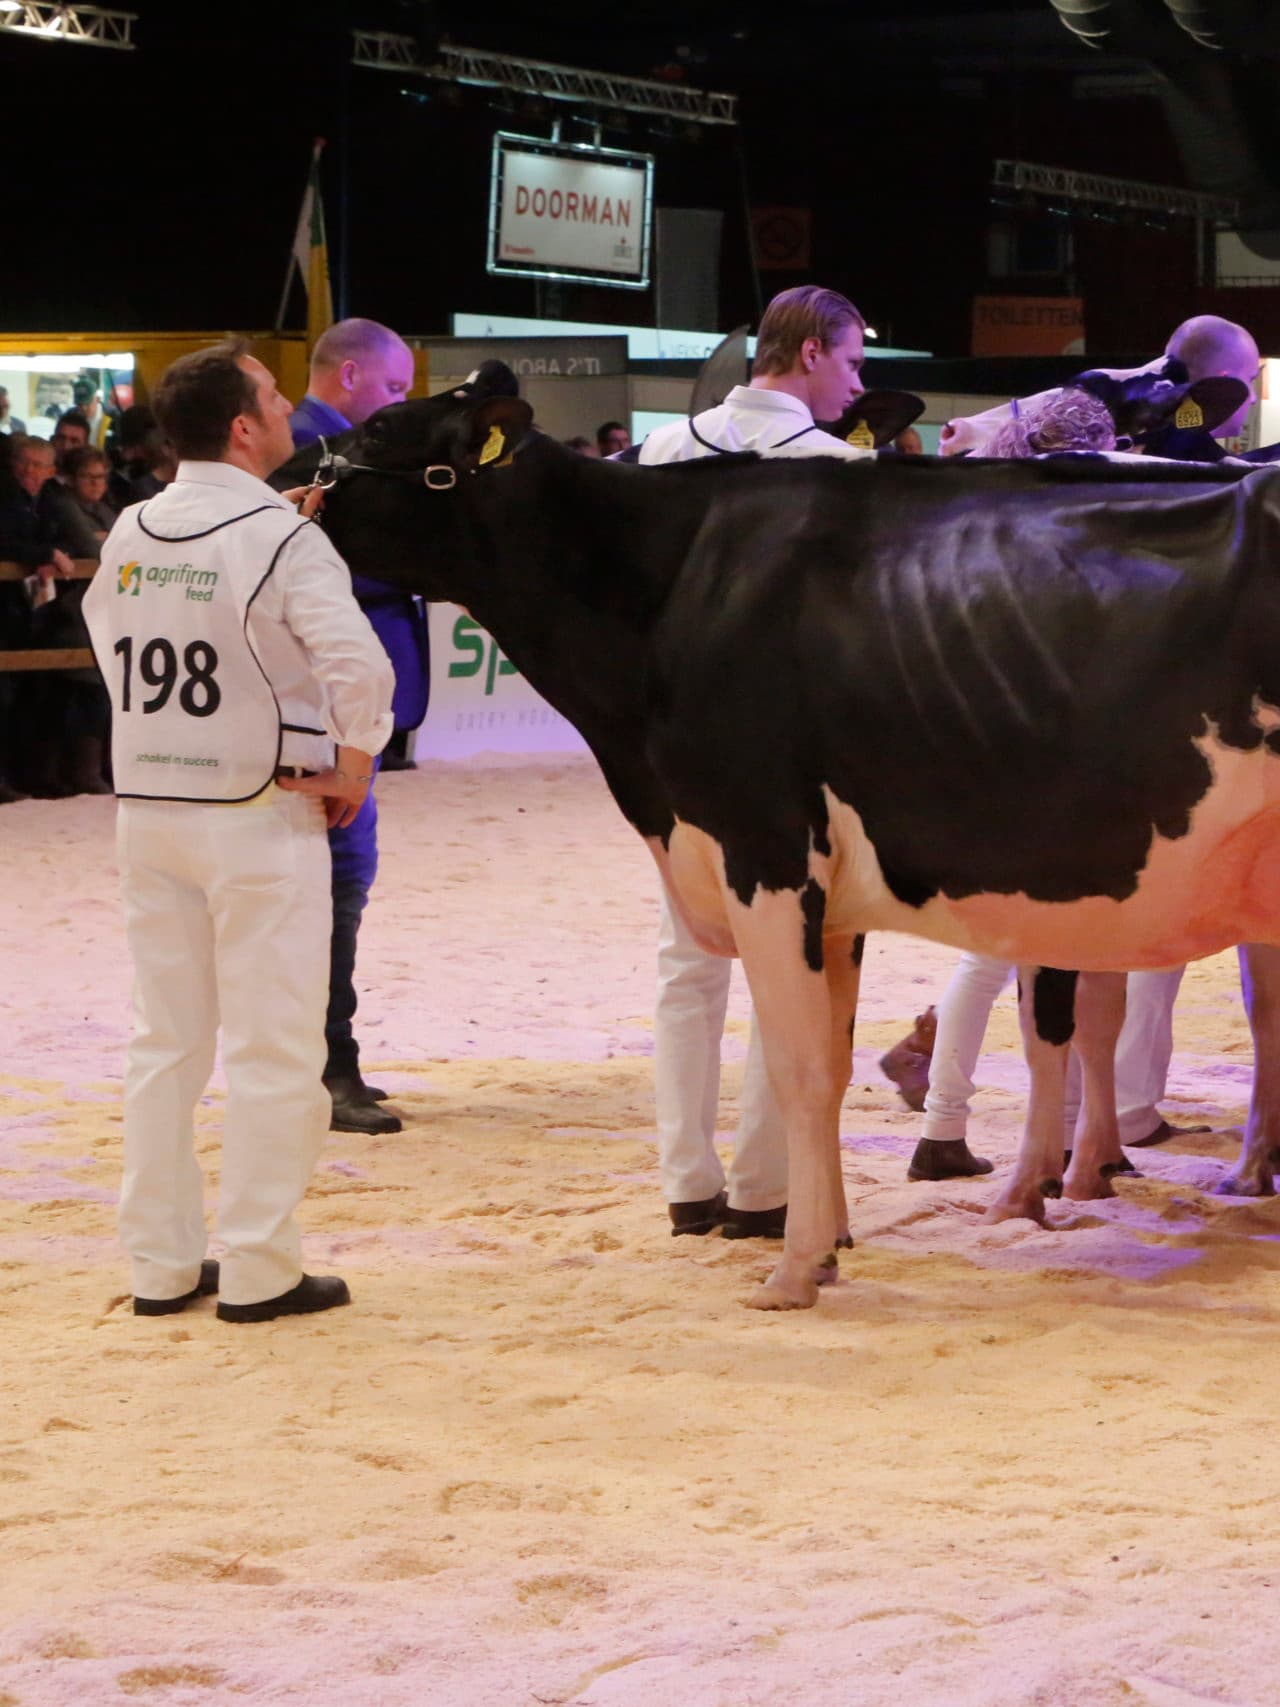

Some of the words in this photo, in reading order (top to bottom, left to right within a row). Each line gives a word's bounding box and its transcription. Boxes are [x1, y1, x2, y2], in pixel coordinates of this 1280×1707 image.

[514, 185, 632, 228] DOORMAN
[146, 563, 218, 587] agrifirm
[185, 586, 214, 602] feed
[114, 636, 222, 717] 198
[183, 756, 219, 767] succes
